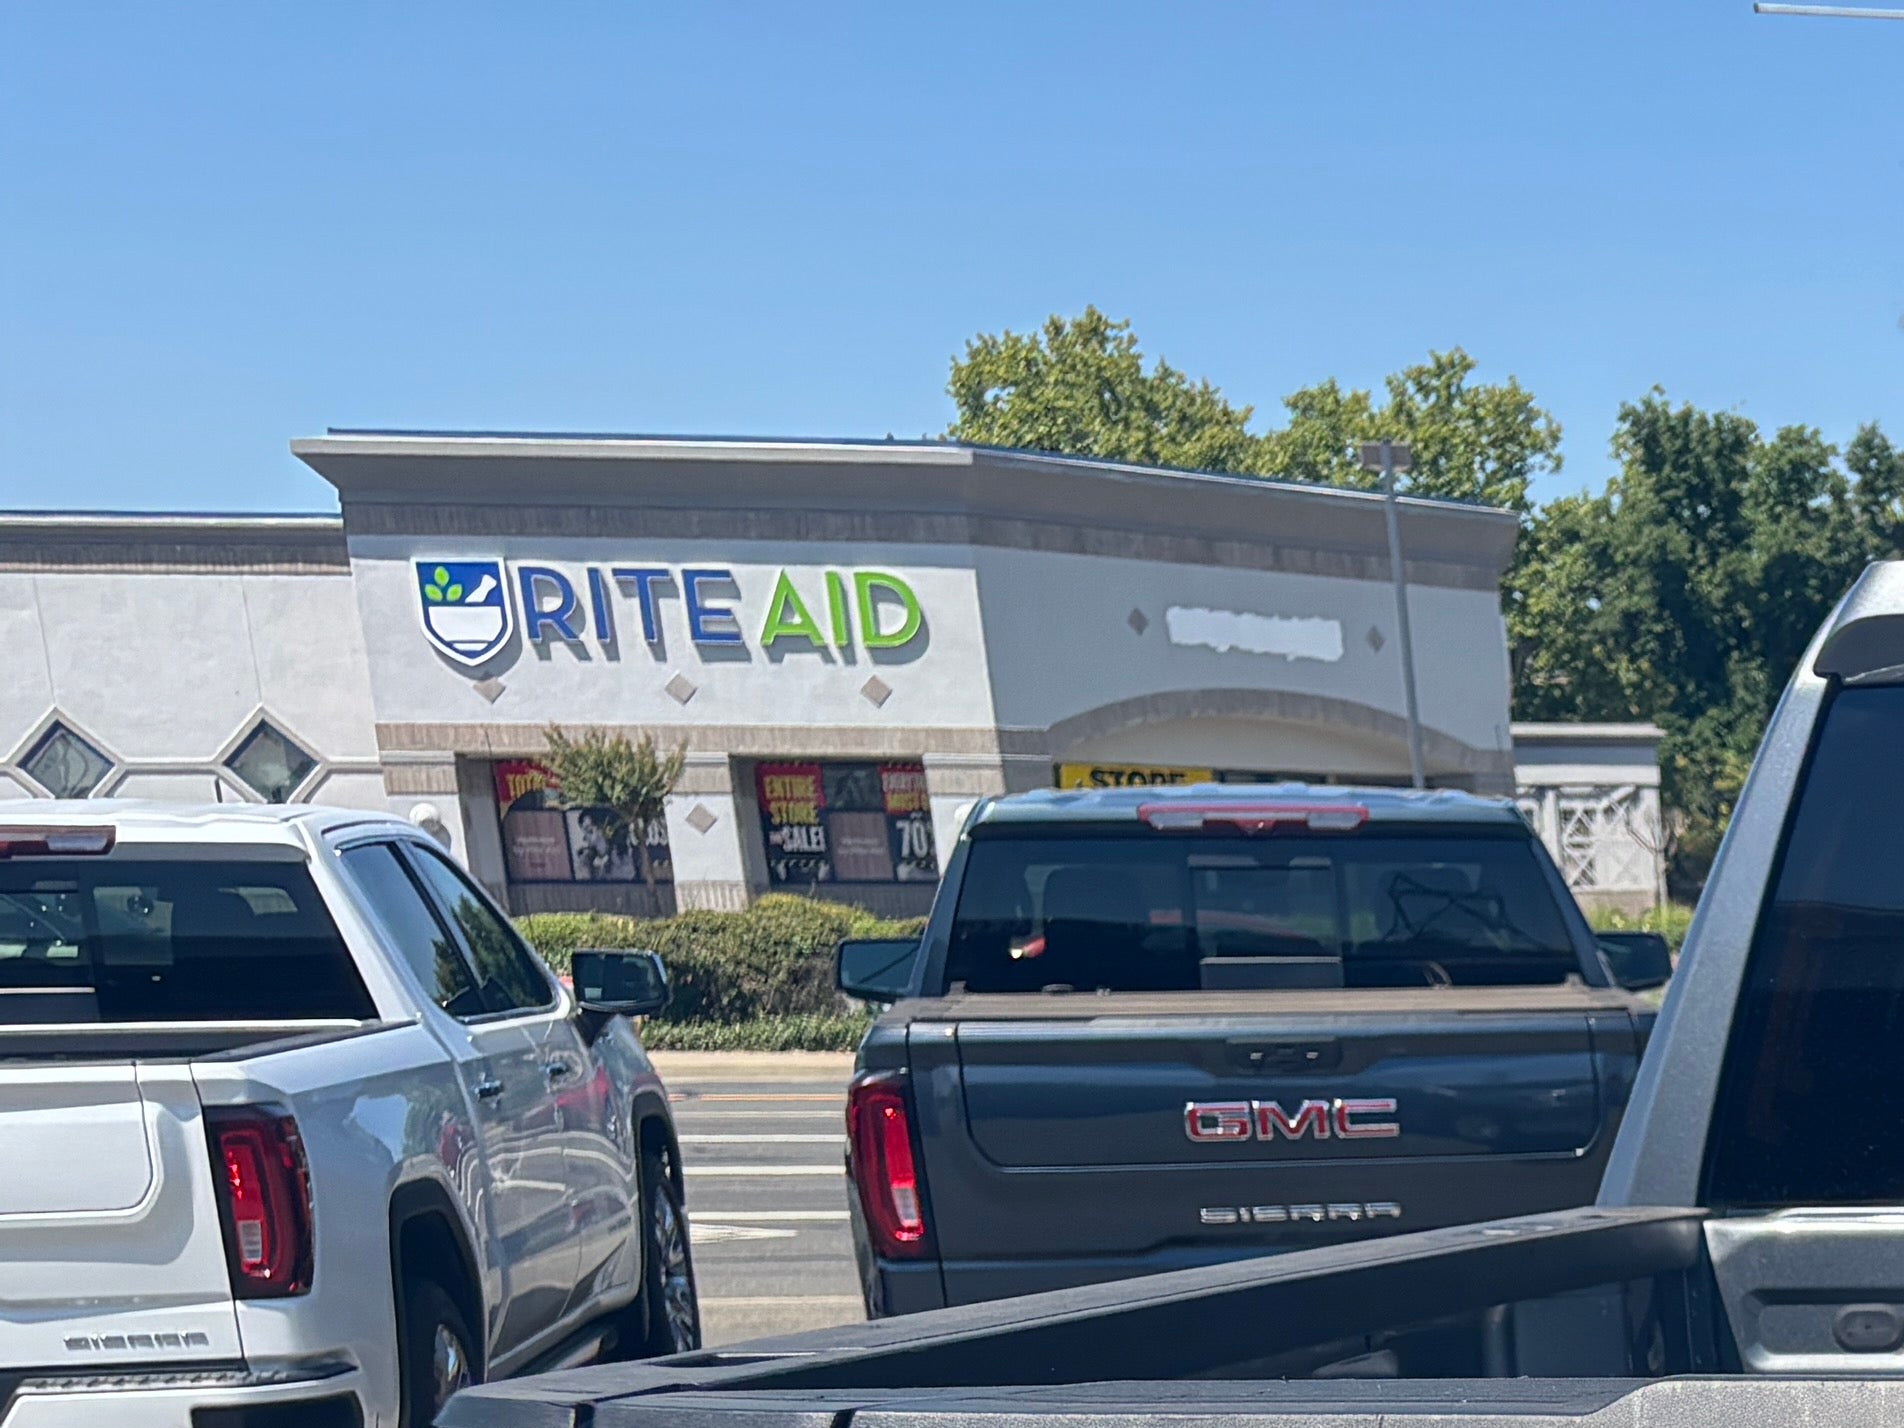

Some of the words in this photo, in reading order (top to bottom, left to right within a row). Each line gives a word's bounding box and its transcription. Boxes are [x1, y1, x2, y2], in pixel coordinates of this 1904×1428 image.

[517, 565, 744, 646] RITE
[759, 568, 923, 649] AID
[1185, 1097, 1400, 1142] GMC
[1199, 1202, 1402, 1224] SIERRA
[63, 1332, 210, 1351] SIERRA
